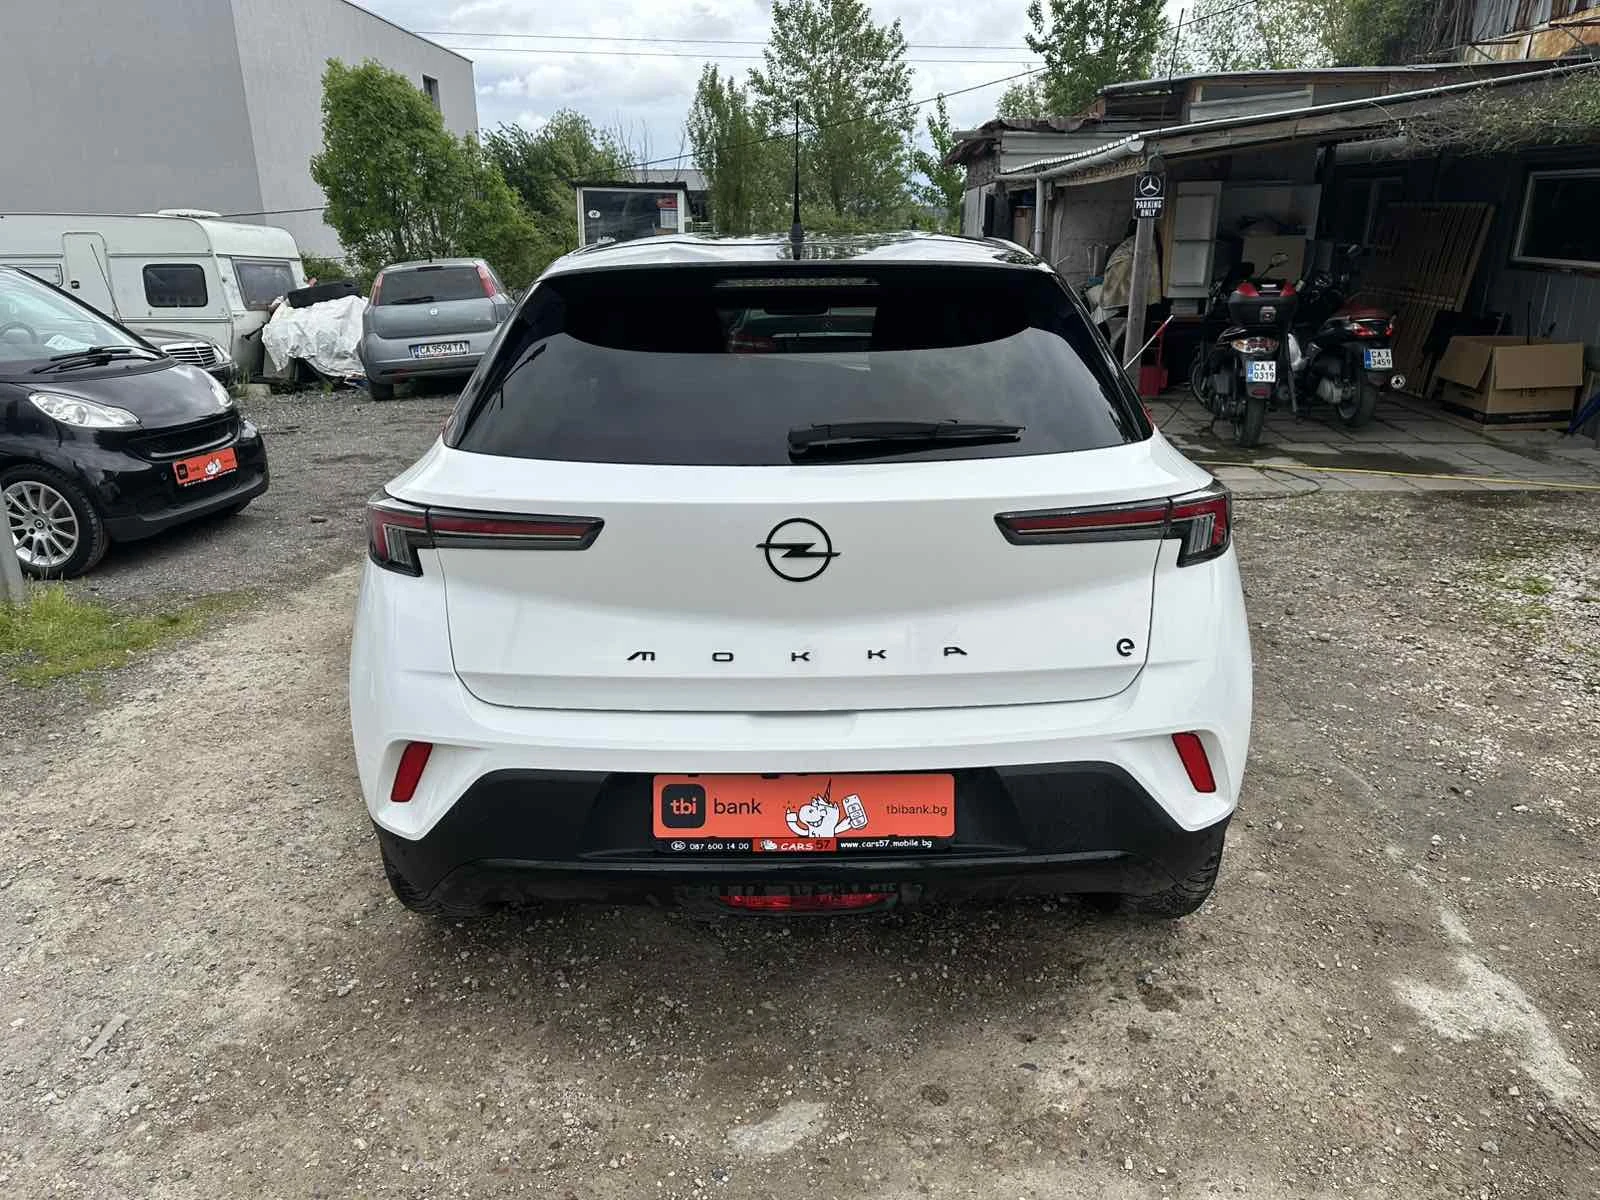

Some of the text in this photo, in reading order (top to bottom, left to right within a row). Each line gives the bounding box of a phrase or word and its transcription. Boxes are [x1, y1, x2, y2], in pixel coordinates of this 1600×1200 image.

[1136, 200, 1162, 208] PARKING
[1140, 208, 1156, 216] ONLY
[1254, 371, 1274, 380] 0319
[670, 797, 948, 816] tbi bank tbibank.bg
[738, 842, 749, 850] 00
[780, 842, 814, 850] CARS
[815, 840, 831, 849] 57
[840, 840, 933, 849] www.cars57.mobile.bg
